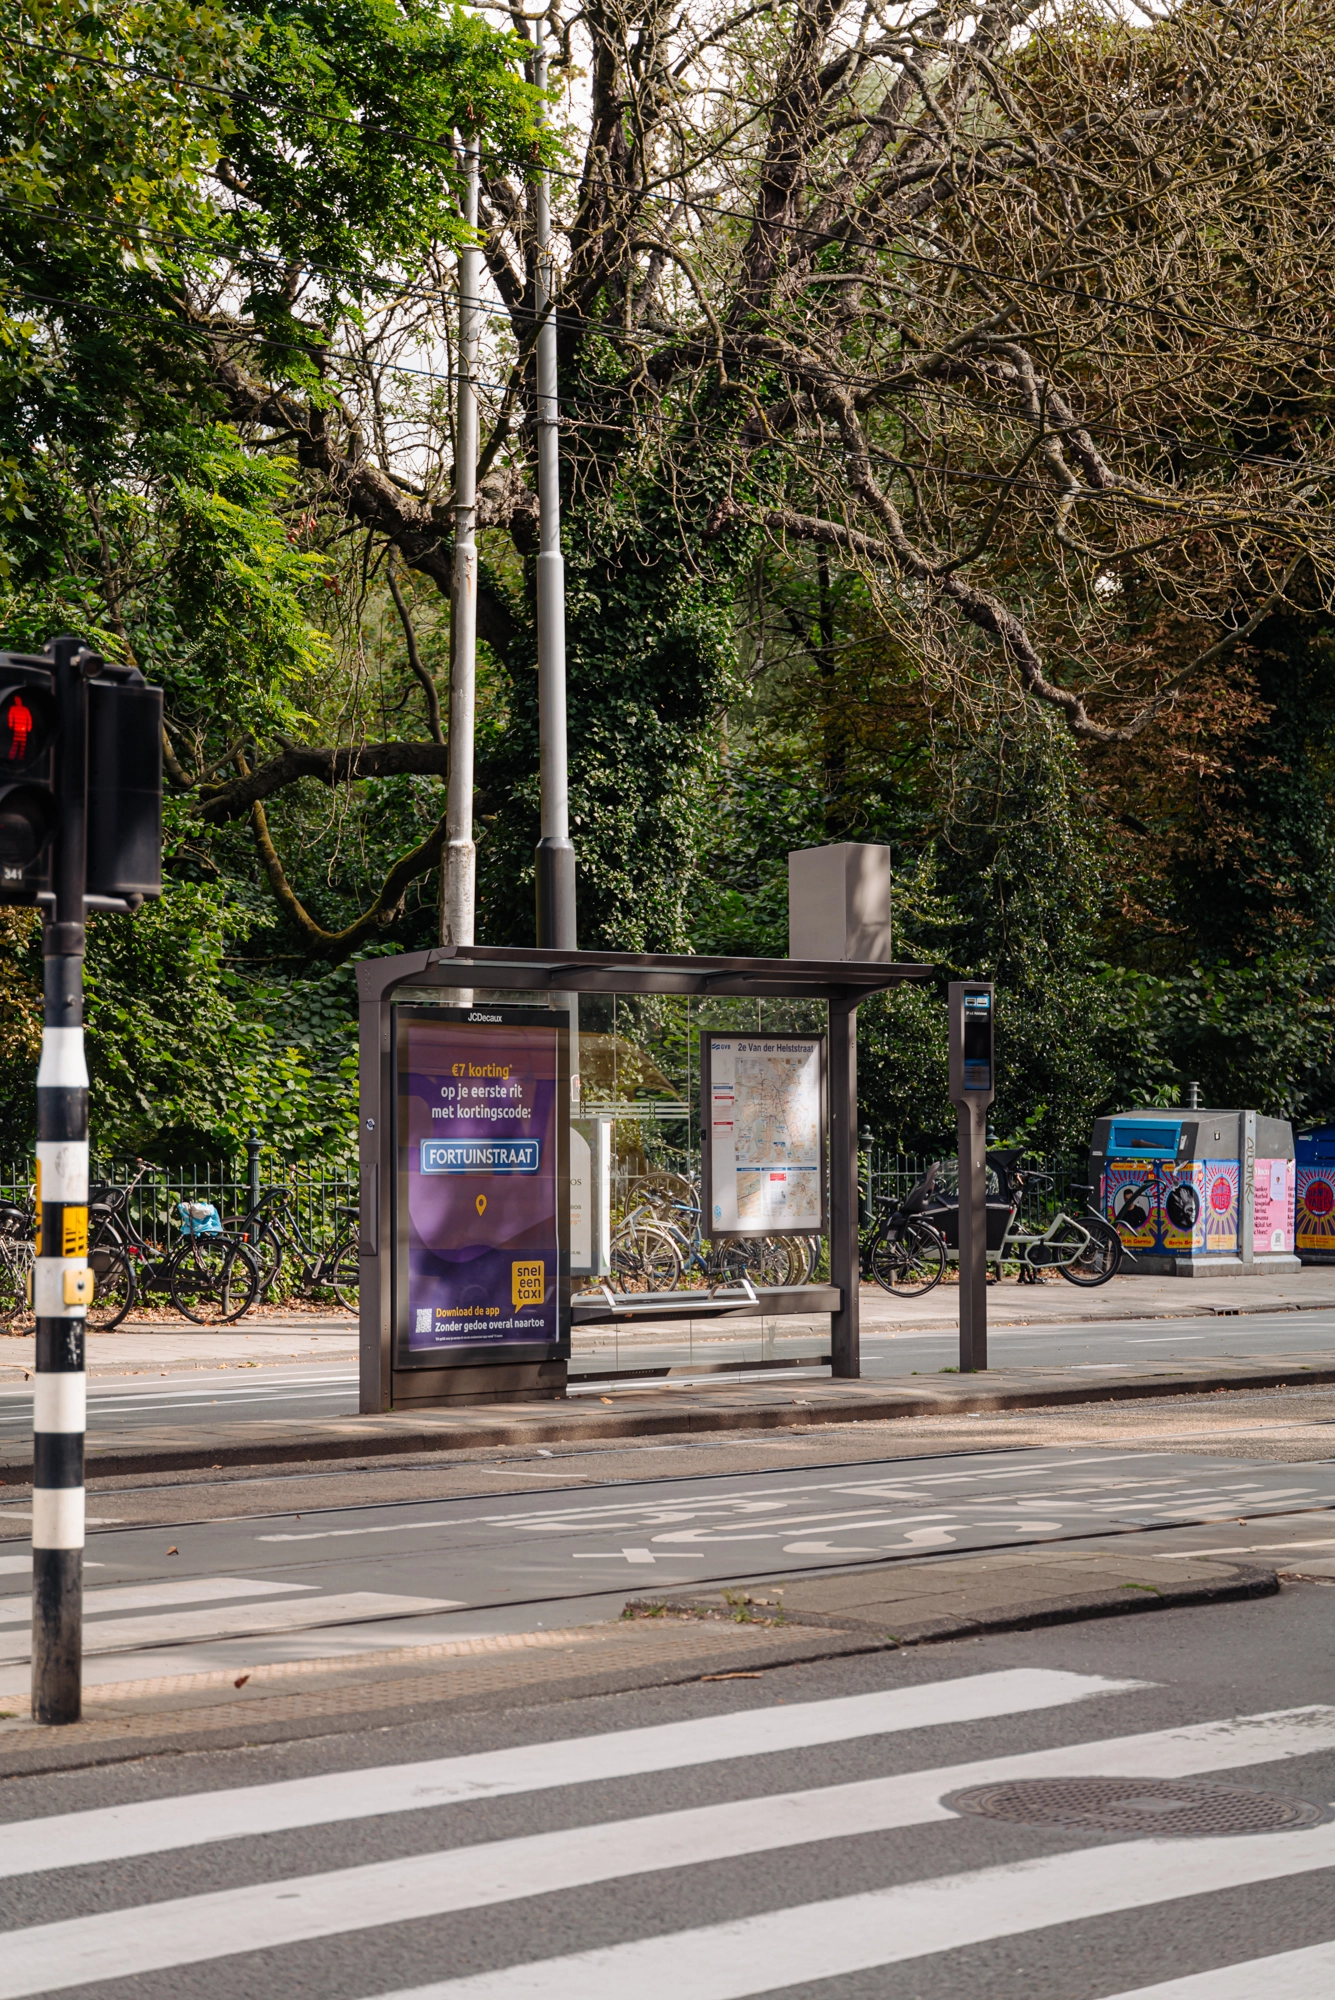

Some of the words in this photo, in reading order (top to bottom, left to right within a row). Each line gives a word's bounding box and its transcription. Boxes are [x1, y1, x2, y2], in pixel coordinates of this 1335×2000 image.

[4, 868, 23, 880] 341
[467, 1012, 503, 1023] JCDecaux
[737, 1042, 747, 1052] 2e
[748, 1043, 762, 1052] Van
[763, 1043, 775, 1052] der
[776, 1043, 814, 1053] Helststraat
[451, 1063, 466, 1077] €7
[441, 1087, 455, 1100] op
[457, 1084, 469, 1100] je
[470, 1086, 507, 1098] eerste
[509, 1084, 523, 1098] rit
[431, 1106, 454, 1119] met
[456, 1104, 532, 1122] kortingscode:
[429, 1148, 533, 1165] FORTUINSTRAAT
[517, 1265, 541, 1277] snel
[519, 1278, 541, 1288] een
[517, 1288, 541, 1300] taxi
[435, 1306, 473, 1318] Download
[474, 1306, 484, 1316] de
[485, 1306, 500, 1317] app
[434, 1321, 462, 1333] Zonder
[464, 1320, 488, 1333] gedoe
[489, 1318, 513, 1330] overal
[514, 1317, 545, 1328] naartoe
